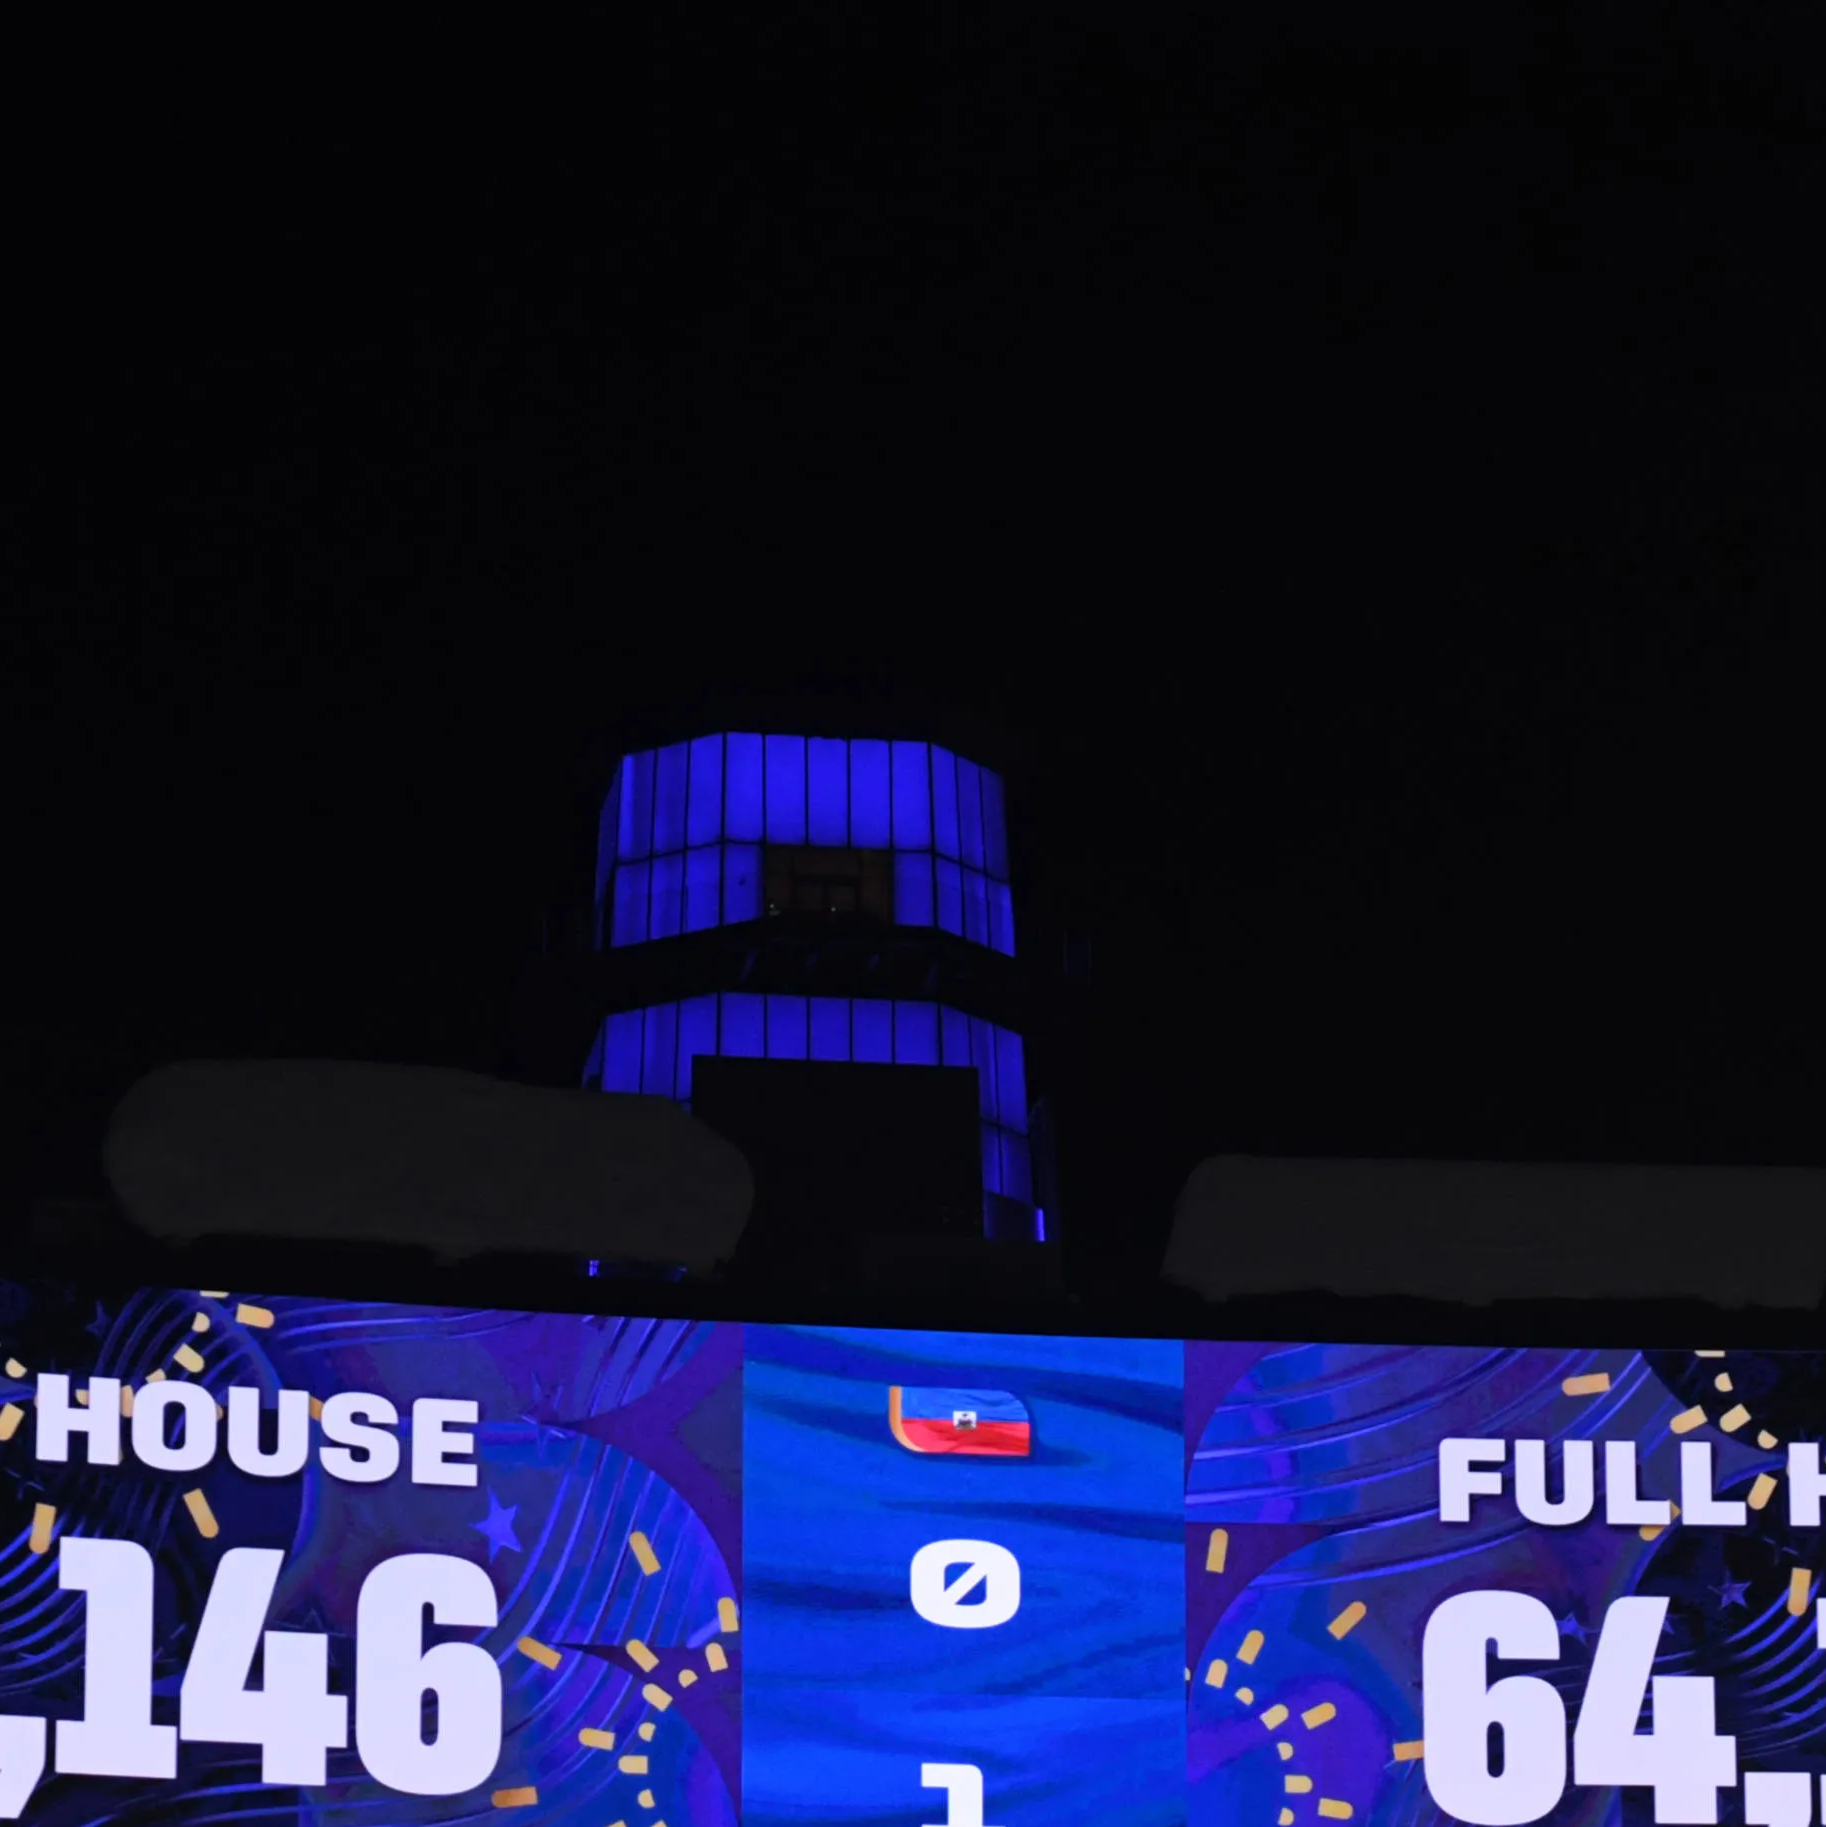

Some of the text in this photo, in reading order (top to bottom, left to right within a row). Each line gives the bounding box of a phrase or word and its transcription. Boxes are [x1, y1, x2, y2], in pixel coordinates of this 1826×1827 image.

[36, 1373, 478, 1486] HOUSE
[1439, 1439, 1746, 1525] FULL
[910, 1539, 1021, 1629] 0
